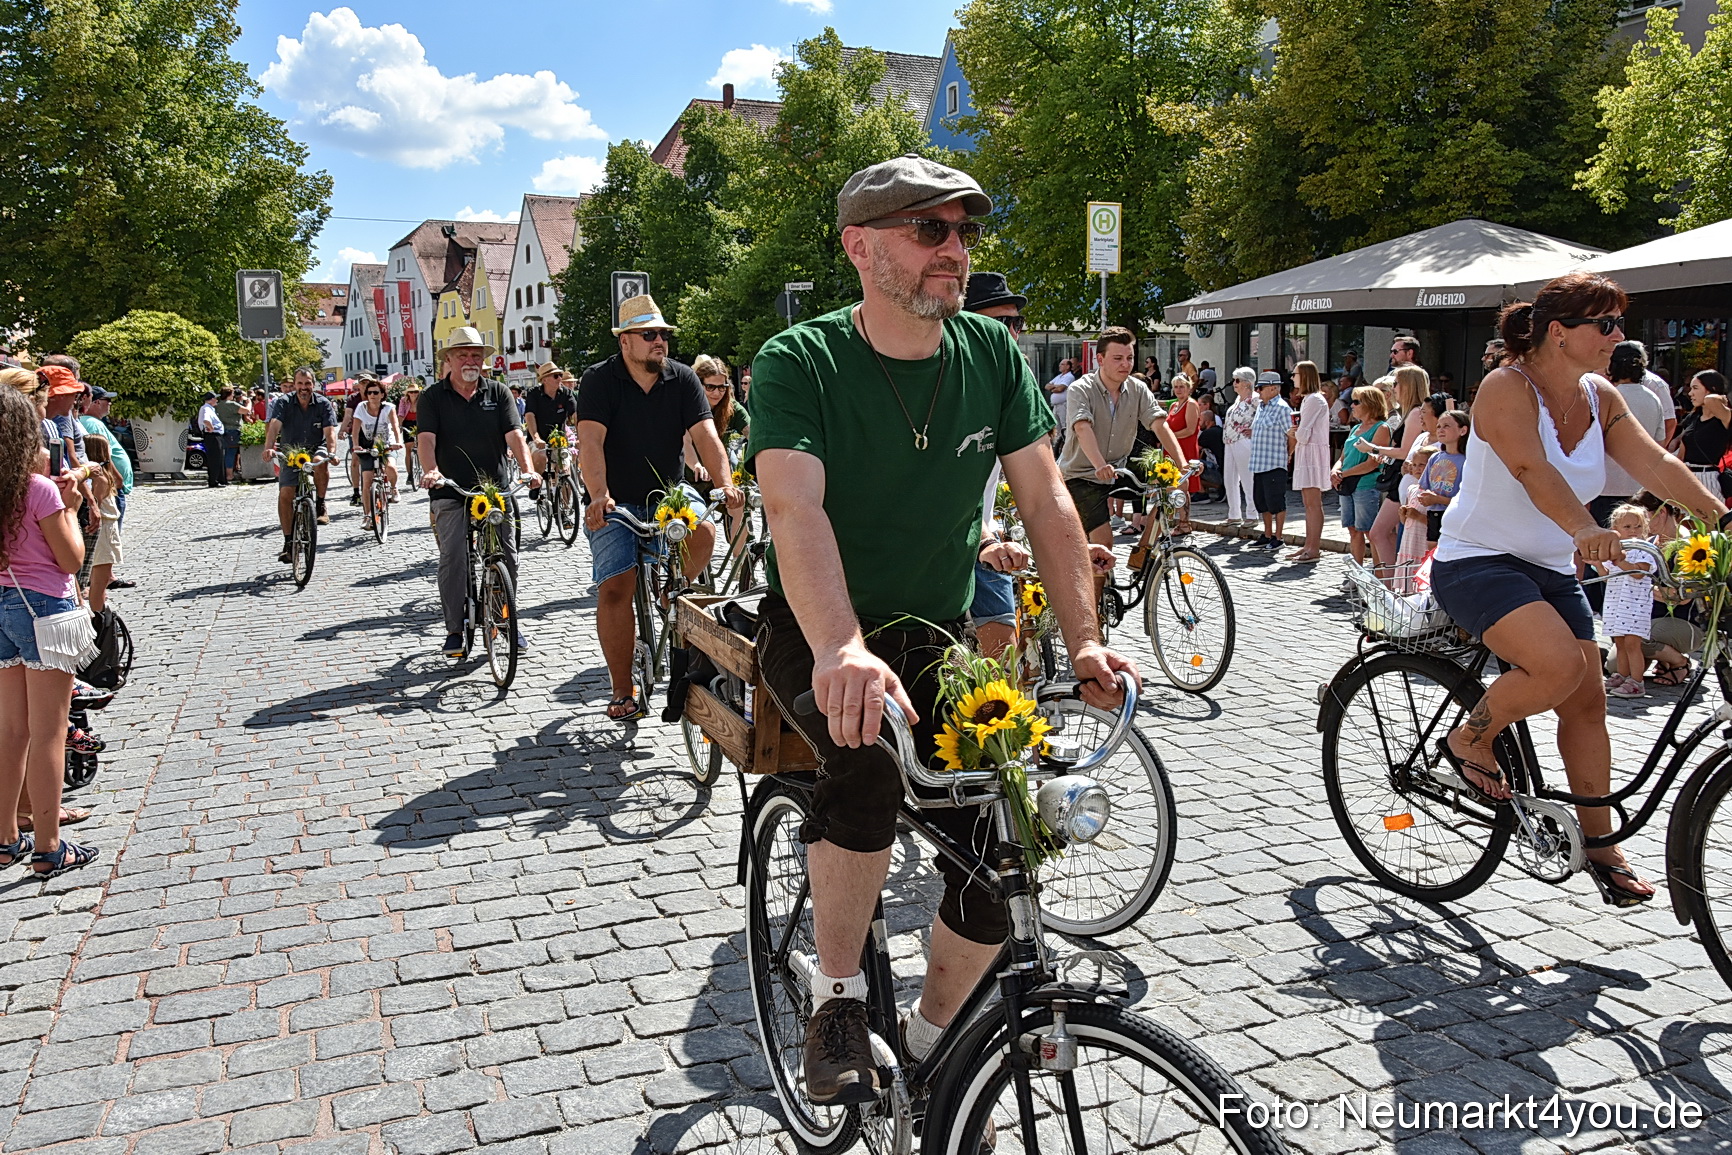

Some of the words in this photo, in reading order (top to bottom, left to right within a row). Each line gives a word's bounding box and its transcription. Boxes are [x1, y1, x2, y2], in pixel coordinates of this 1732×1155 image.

[1099, 214, 1110, 229] H
[1296, 297, 1333, 312] LORENZO
[1422, 292, 1466, 307] LORENZO
[1191, 307, 1223, 321] LORENZO
